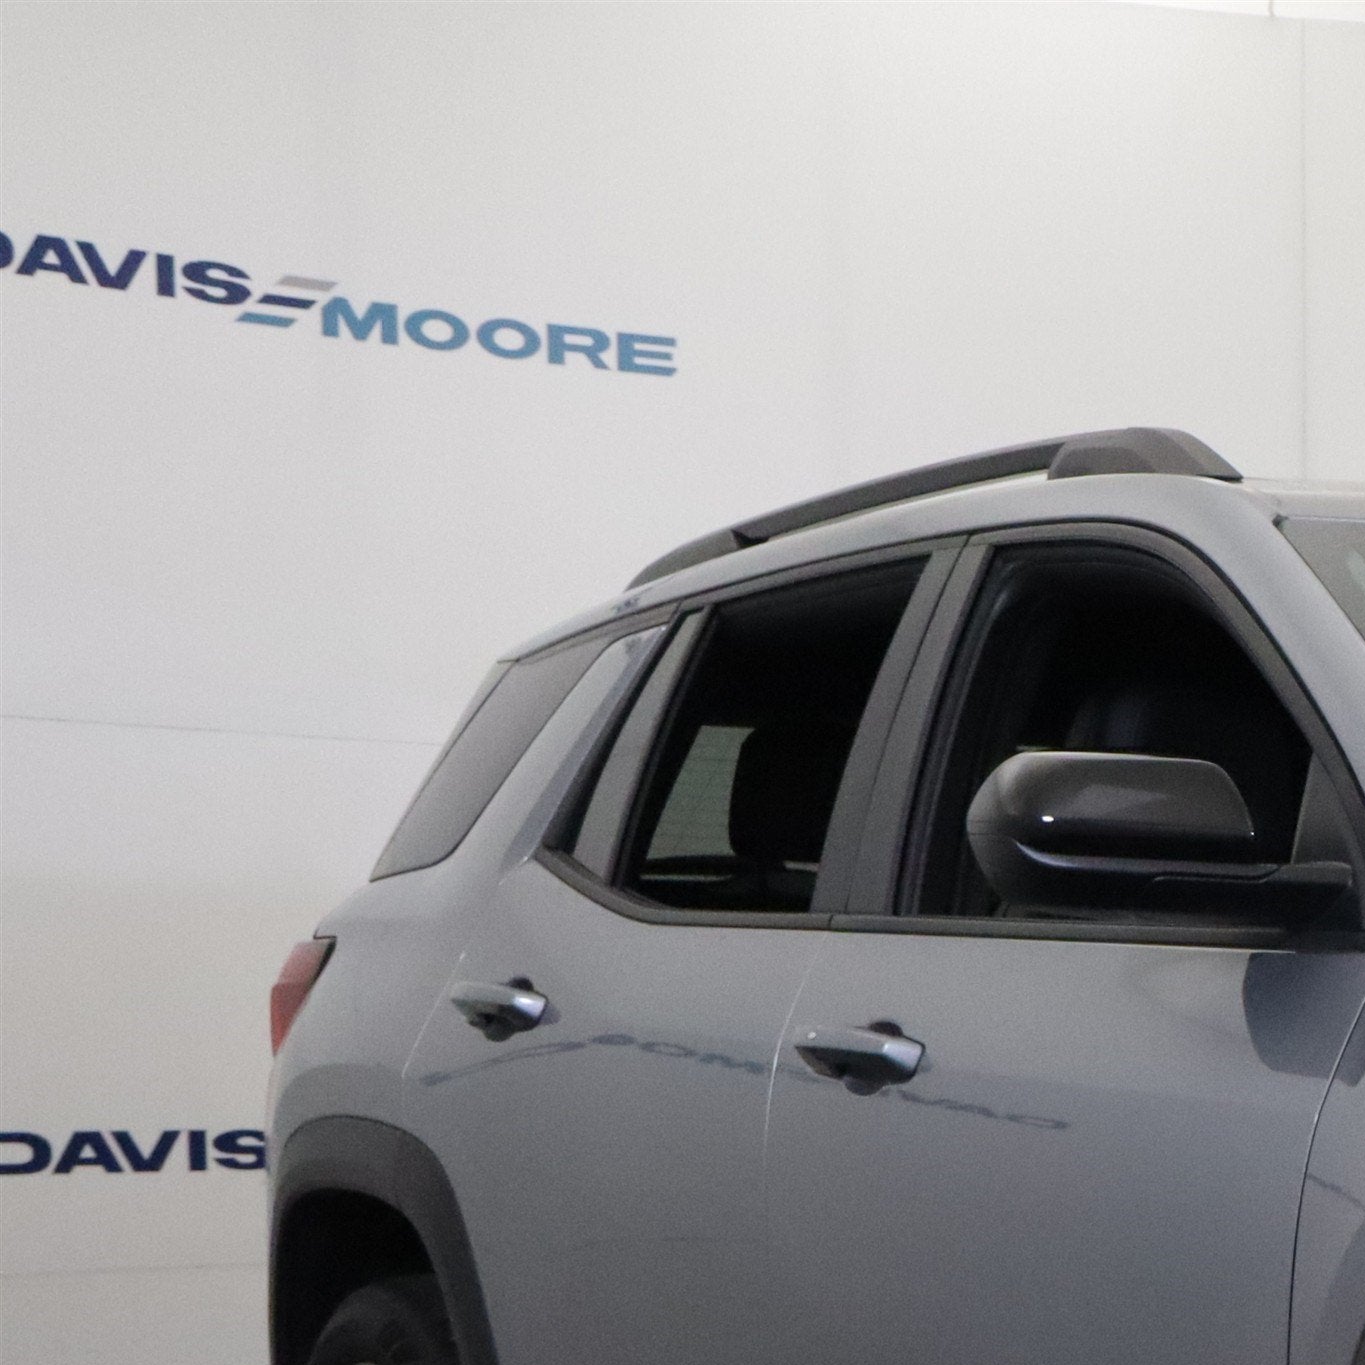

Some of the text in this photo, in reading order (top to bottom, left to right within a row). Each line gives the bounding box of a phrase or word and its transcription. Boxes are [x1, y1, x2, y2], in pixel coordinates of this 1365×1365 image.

[0, 231, 678, 377] AVIS MOORE
[0, 1129, 267, 1175] DAVIS
